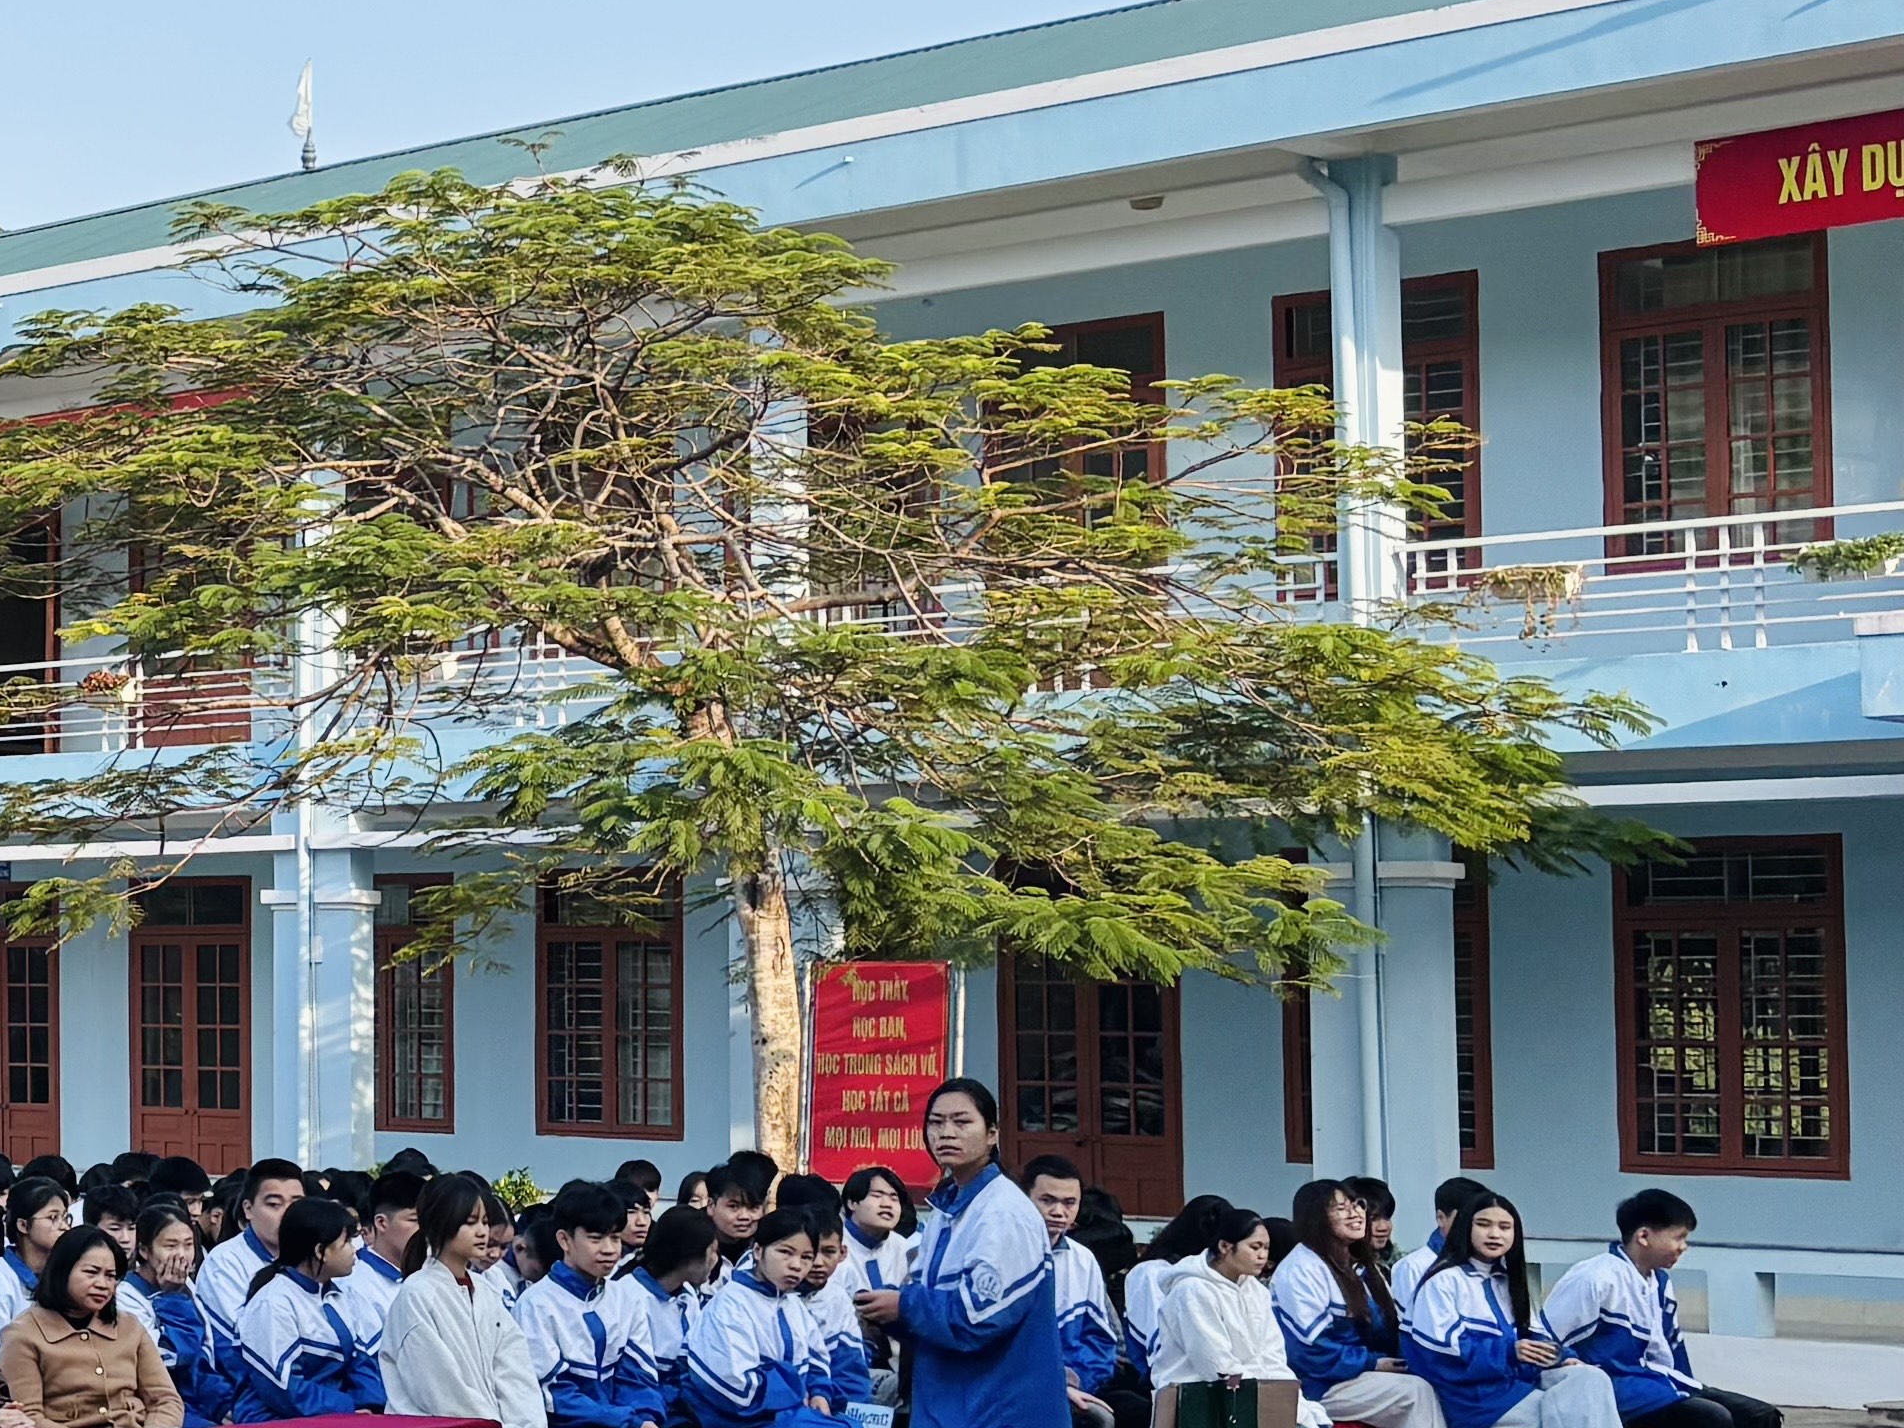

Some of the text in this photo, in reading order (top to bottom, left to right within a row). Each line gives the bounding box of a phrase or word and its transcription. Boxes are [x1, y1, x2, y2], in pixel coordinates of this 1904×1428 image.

[1777, 142, 1849, 205] XÂY
[852, 980, 876, 1004] HỌC
[853, 1016, 907, 1042] HỌC BẠN,
[817, 1053, 840, 1077] HỌC
[844, 1053, 882, 1076] TRONG
[885, 1049, 917, 1076] SÁCH
[842, 1083, 910, 1114] HỌC TẤT CẢ
[824, 1126, 848, 1151] MỌI
[877, 1127, 901, 1152] MỌI
